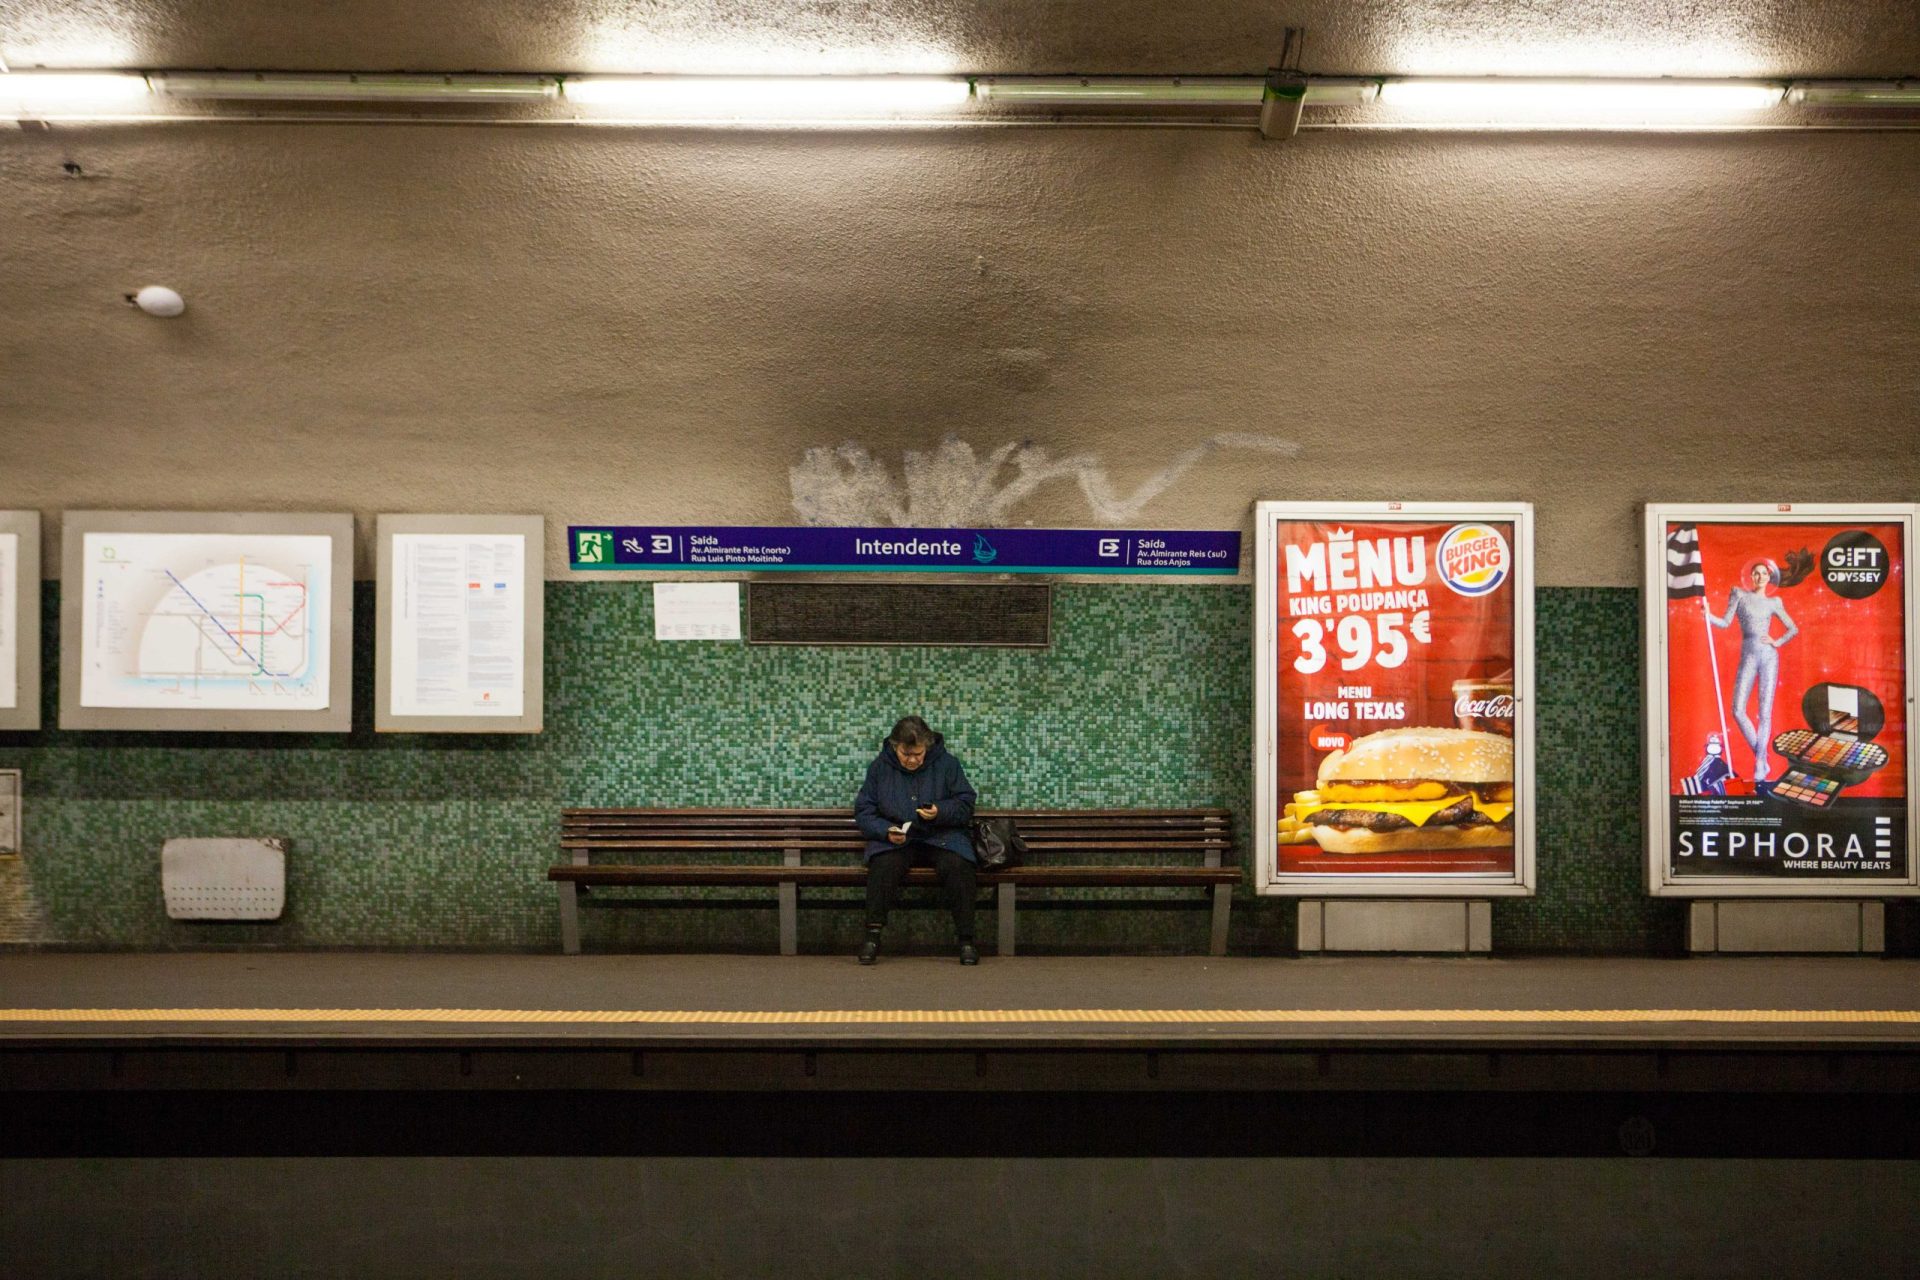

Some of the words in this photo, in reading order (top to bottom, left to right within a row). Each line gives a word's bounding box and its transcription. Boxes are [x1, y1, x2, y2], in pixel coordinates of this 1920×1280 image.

[690, 535, 718, 545] Saída
[1138, 539, 1166, 549] Saída
[691, 546, 703, 554] Av.
[703, 546, 742, 554] Almirante
[743, 546, 760, 554] Reis
[761, 546, 791, 555] (norte)
[855, 538, 962, 555] Intendente
[1446, 536, 1498, 562] BURGER
[691, 554, 707, 563] Rua
[725, 555, 746, 563] Pinto
[747, 555, 784, 563] Moitinho
[1137, 550, 1150, 558] Av.
[1150, 549, 1188, 558] Almirante
[1189, 550, 1206, 558] Reis
[1207, 550, 1227, 559] (sul)
[1827, 546, 1881, 567] GIFT
[1137, 558, 1152, 566] Rua
[1153, 558, 1168, 566] dos
[1169, 559, 1191, 568] Anjos
[1285, 535, 1427, 593] MENU
[1448, 548, 1501, 580] KING
[1827, 571, 1881, 582] ODYSSEY
[1289, 595, 1332, 616] KING
[1336, 589, 1429, 613] POUPANÇA
[1338, 686, 1372, 699] MENU
[1304, 702, 1350, 720] LONG
[1354, 702, 1405, 720] TEXAS
[1317, 737, 1345, 747] NOVO
[1679, 831, 1864, 858] SEPHORA
[1783, 860, 1817, 869] WHERE
[1821, 861, 1857, 869] BEAUTY
[1861, 861, 1891, 869] BEATS
